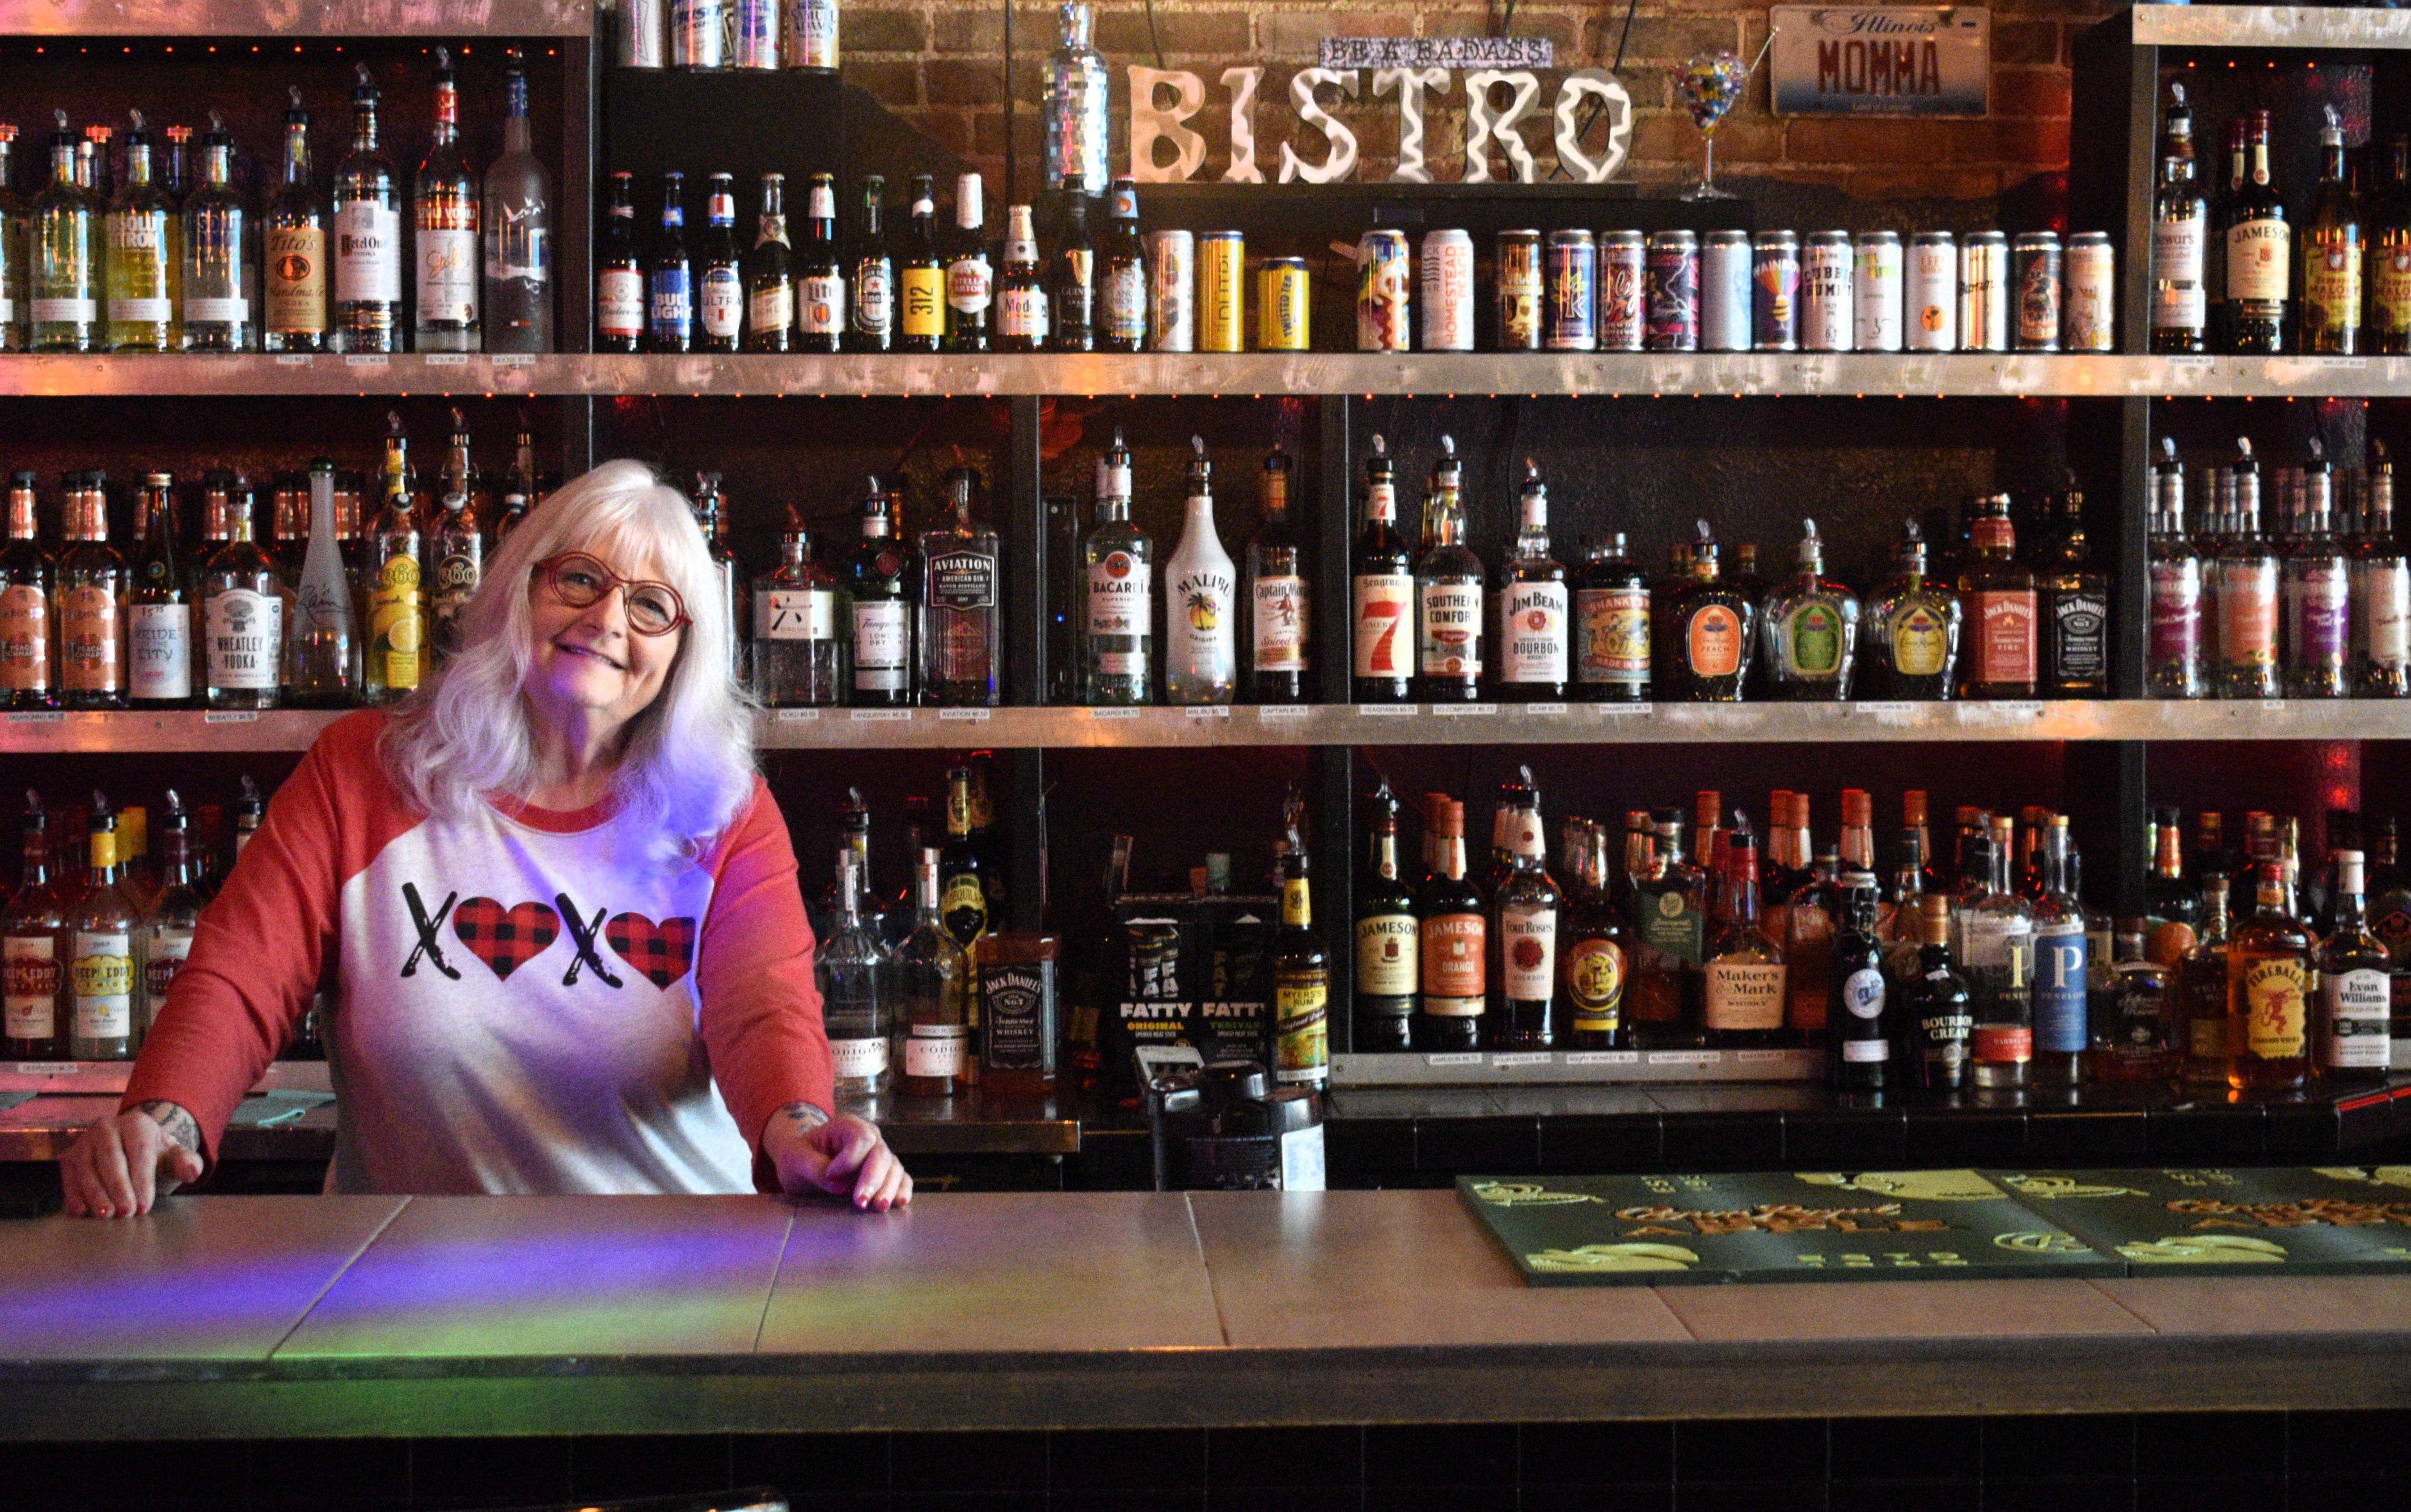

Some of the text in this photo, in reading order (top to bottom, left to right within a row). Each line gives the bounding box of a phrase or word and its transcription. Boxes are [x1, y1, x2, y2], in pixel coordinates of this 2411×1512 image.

[790, 9, 835, 23] SAMUL
[1829, 12, 1937, 35] Illinois
[1332, 39, 1545, 61] BE A BADASS
[1817, 40, 1940, 96] MOMMA
[1127, 65, 1631, 184] BISTRO
[368, 235, 388, 249] On
[2235, 225, 2290, 244] JAMESON
[270, 234, 317, 252] Tito's
[953, 274, 984, 285] STELLA
[855, 291, 895, 304] Heinen
[1061, 287, 1097, 297] GUINSS
[1444, 245, 1457, 345] HOMESTEAD
[655, 293, 688, 307] BUD
[703, 296, 742, 307] ULTRA
[910, 286, 934, 316] 312
[1006, 298, 1048, 314] Modo
[1279, 275, 1293, 338] TWISTED TEA
[652, 306, 693, 320] LIGHT
[934, 558, 991, 571] AVIATION
[386, 564, 421, 590] 360
[439, 562, 477, 590] 360
[1093, 578, 1144, 594] BACARÍ
[1177, 573, 1232, 598] MALIBU
[1255, 582, 1287, 601] Captain
[1509, 591, 1563, 616] JIM BEAM
[1984, 603, 2003, 619] JACK
[2056, 602, 2075, 617] JACK
[862, 619, 906, 629] Tanqu
[1429, 611, 1472, 624] COMFOR
[1190, 633, 1218, 642] ORIGINA
[1261, 636, 1291, 647] Spiced
[1361, 600, 1407, 671] 7
[217, 637, 263, 652] WHEATLEY
[1513, 642, 1559, 654] BOURBON
[223, 654, 256, 669] VODKA
[1361, 922, 1418, 938] JAMESON
[1428, 922, 1483, 937] JAMESON
[1505, 921, 1553, 934] Four Roses
[400, 882, 624, 989] X X
[107, 965, 130, 978] EDDY
[1442, 962, 1475, 972] ORANGE
[2054, 946, 2083, 988] P
[1716, 969, 1778, 981] Maker's
[2248, 964, 2303, 988] FIREBALL
[985, 972, 1042, 994] JACK DANIEL'S
[1734, 982, 1776, 994] Mark
[2349, 981, 2379, 993] Evan
[1283, 991, 1322, 999] MYERS'S
[2340, 992, 2387, 1003] Williams
[1120, 1002, 1192, 1018] FATTY
[996, 1017, 1034, 1026] Tennessee
[1127, 1022, 1185, 1031] ORIGINAL
[1923, 1015, 1973, 1030] BOURBON
[1930, 1027, 1969, 1040] CREAM
[830, 1047, 876, 1056] ODIGO
